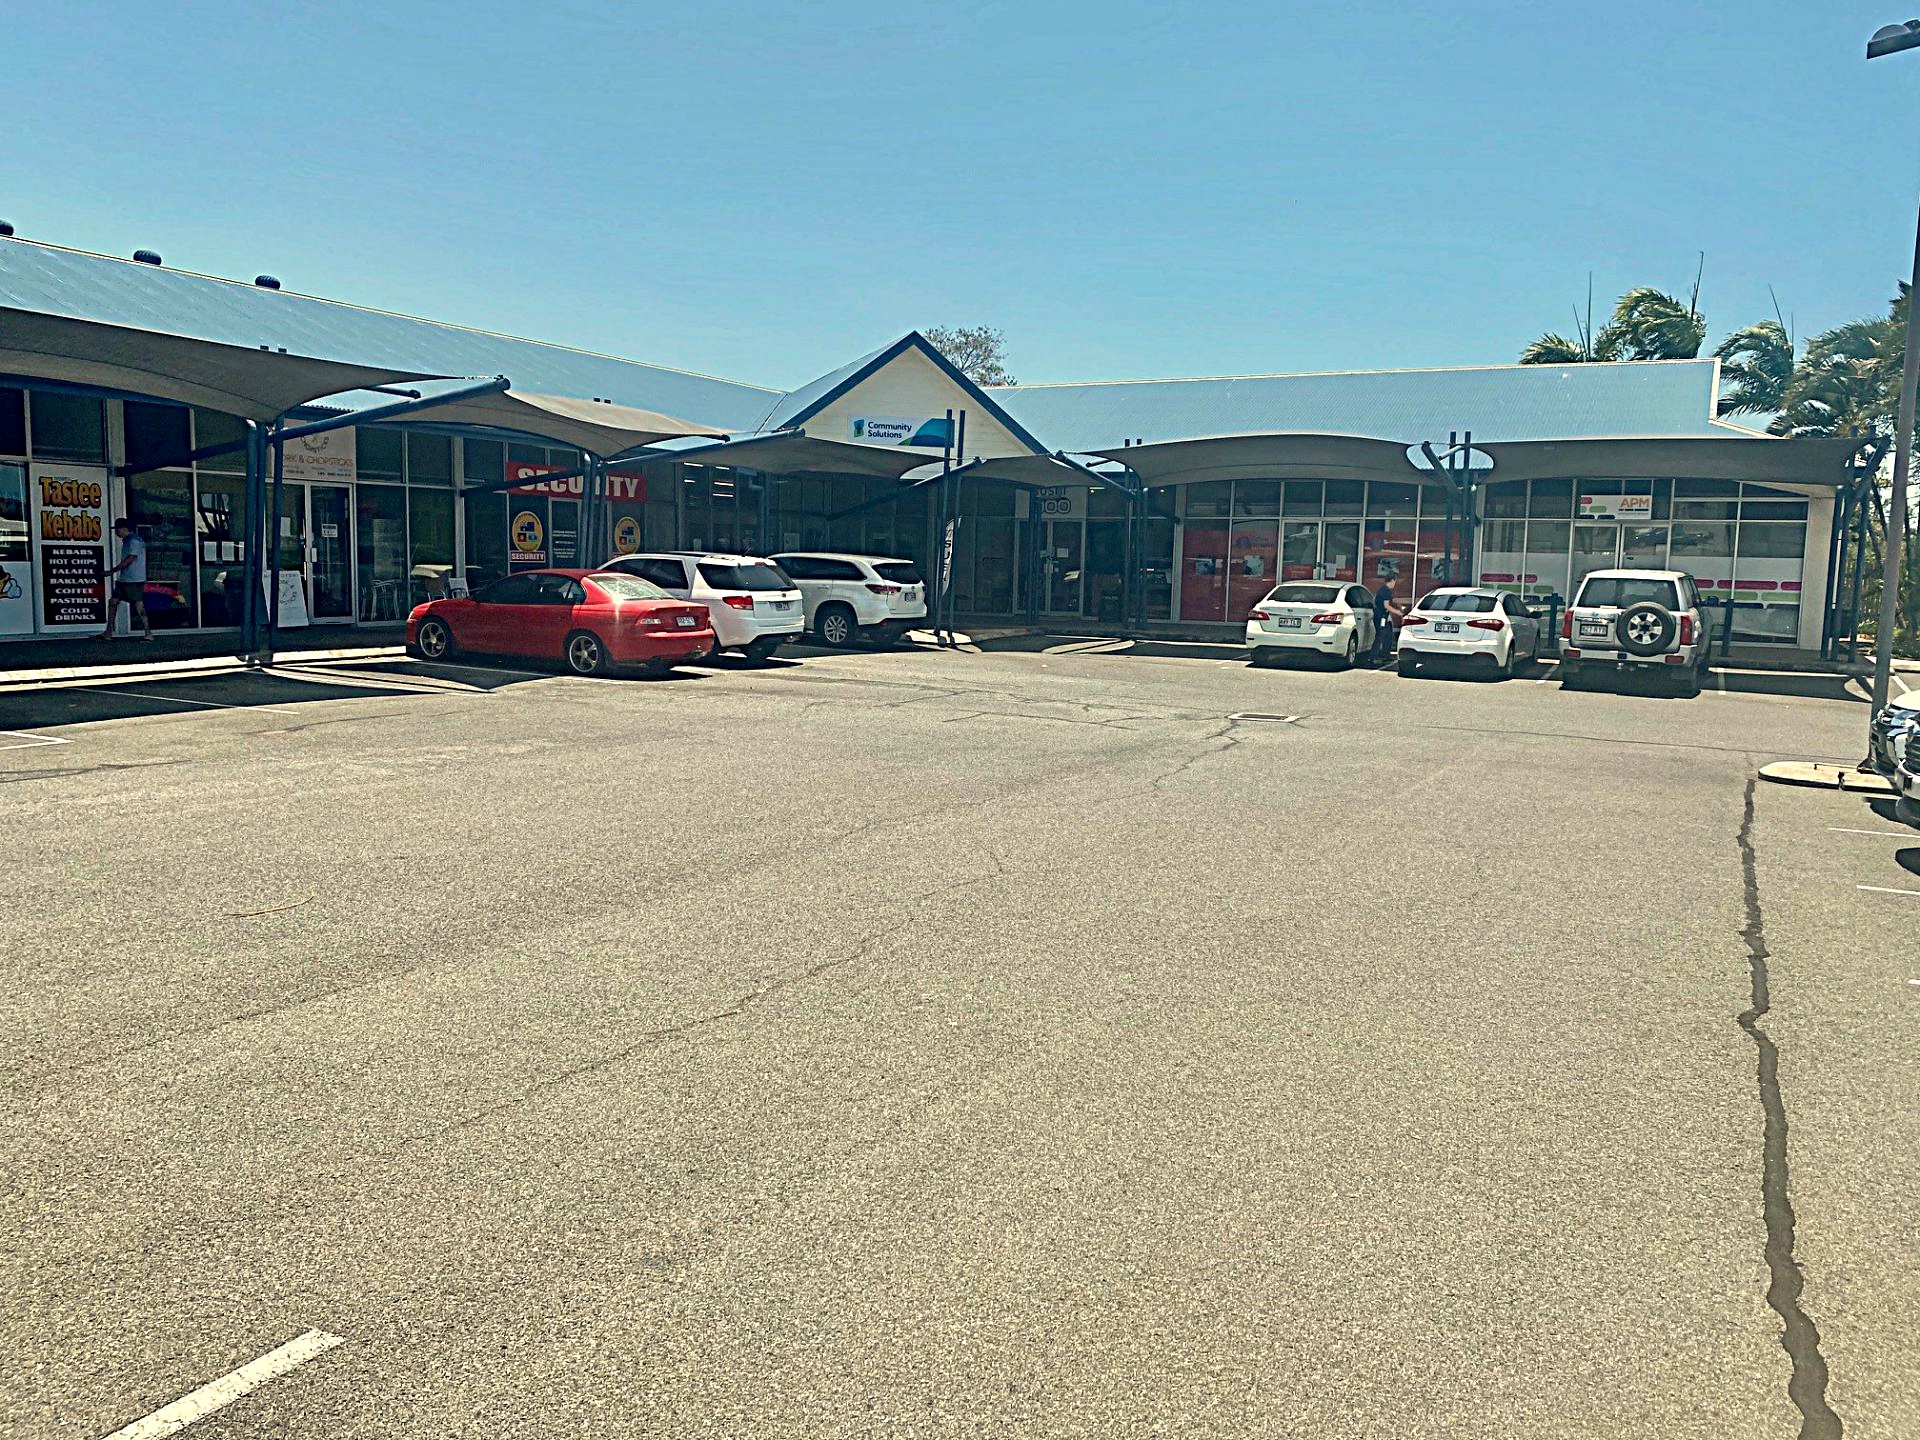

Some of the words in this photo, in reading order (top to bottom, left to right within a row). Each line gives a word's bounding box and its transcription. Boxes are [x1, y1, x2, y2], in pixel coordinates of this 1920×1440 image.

[867, 421, 912, 433] Community
[867, 429, 903, 439] Solutions
[39, 476, 101, 509] Tastee
[1620, 497, 1650, 508] APM
[40, 509, 101, 542] Kebabs
[511, 552, 545, 561] SECURITY
[55, 613, 96, 621] DRINKS
